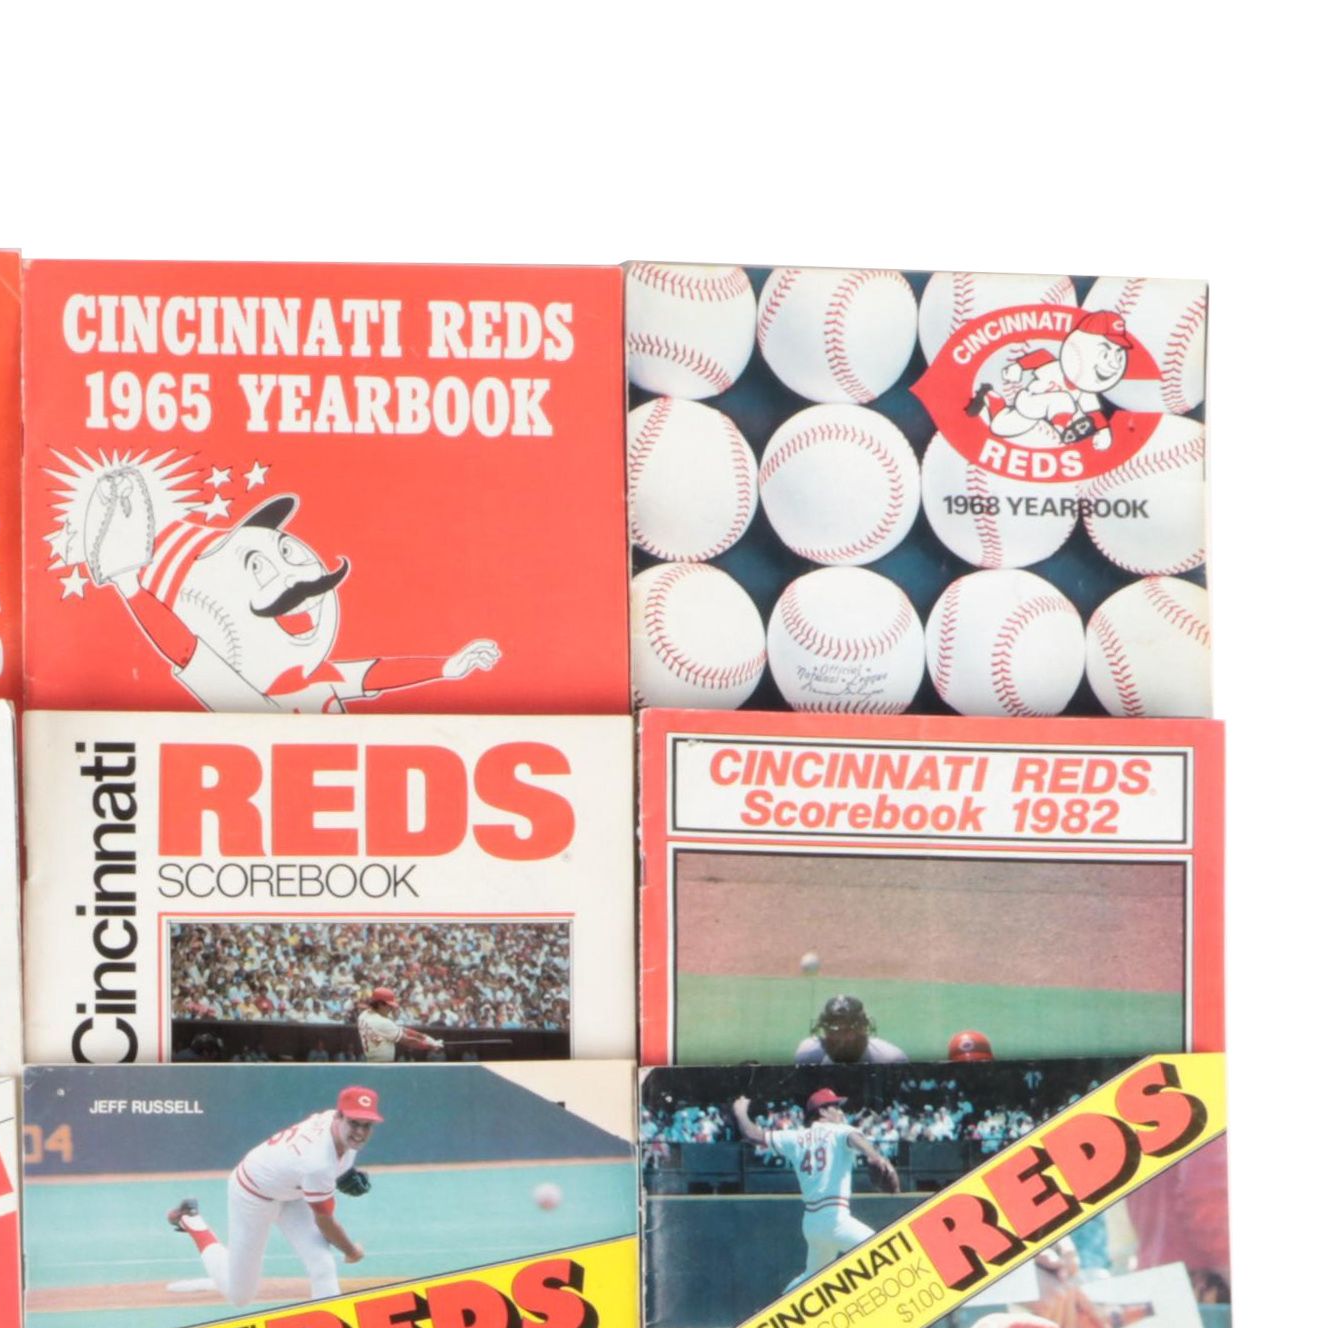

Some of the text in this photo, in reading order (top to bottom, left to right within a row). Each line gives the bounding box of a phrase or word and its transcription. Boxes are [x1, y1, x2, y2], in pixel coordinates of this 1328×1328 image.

[63, 294, 574, 361] CINCINNATI REDS
[952, 311, 1072, 364] CINCINNATI
[85, 371, 553, 437] 1965 YEARBOOK
[978, 438, 1085, 478] REDS
[943, 495, 1149, 518] 1968 YEARBOOK
[709, 749, 1152, 795] CINCINNATI REDS
[158, 741, 575, 861] REDS
[740, 790, 1120, 834] Scorebook 1982
[72, 741, 138, 1063] Cincinnati
[158, 864, 420, 898] SCOREBOOK
[89, 1100, 203, 1114] JEFF RUSSELL
[800, 1147, 826, 1175] 49
[909, 1062, 1208, 1290] REDS
[897, 1282, 945, 1323] $1.00
